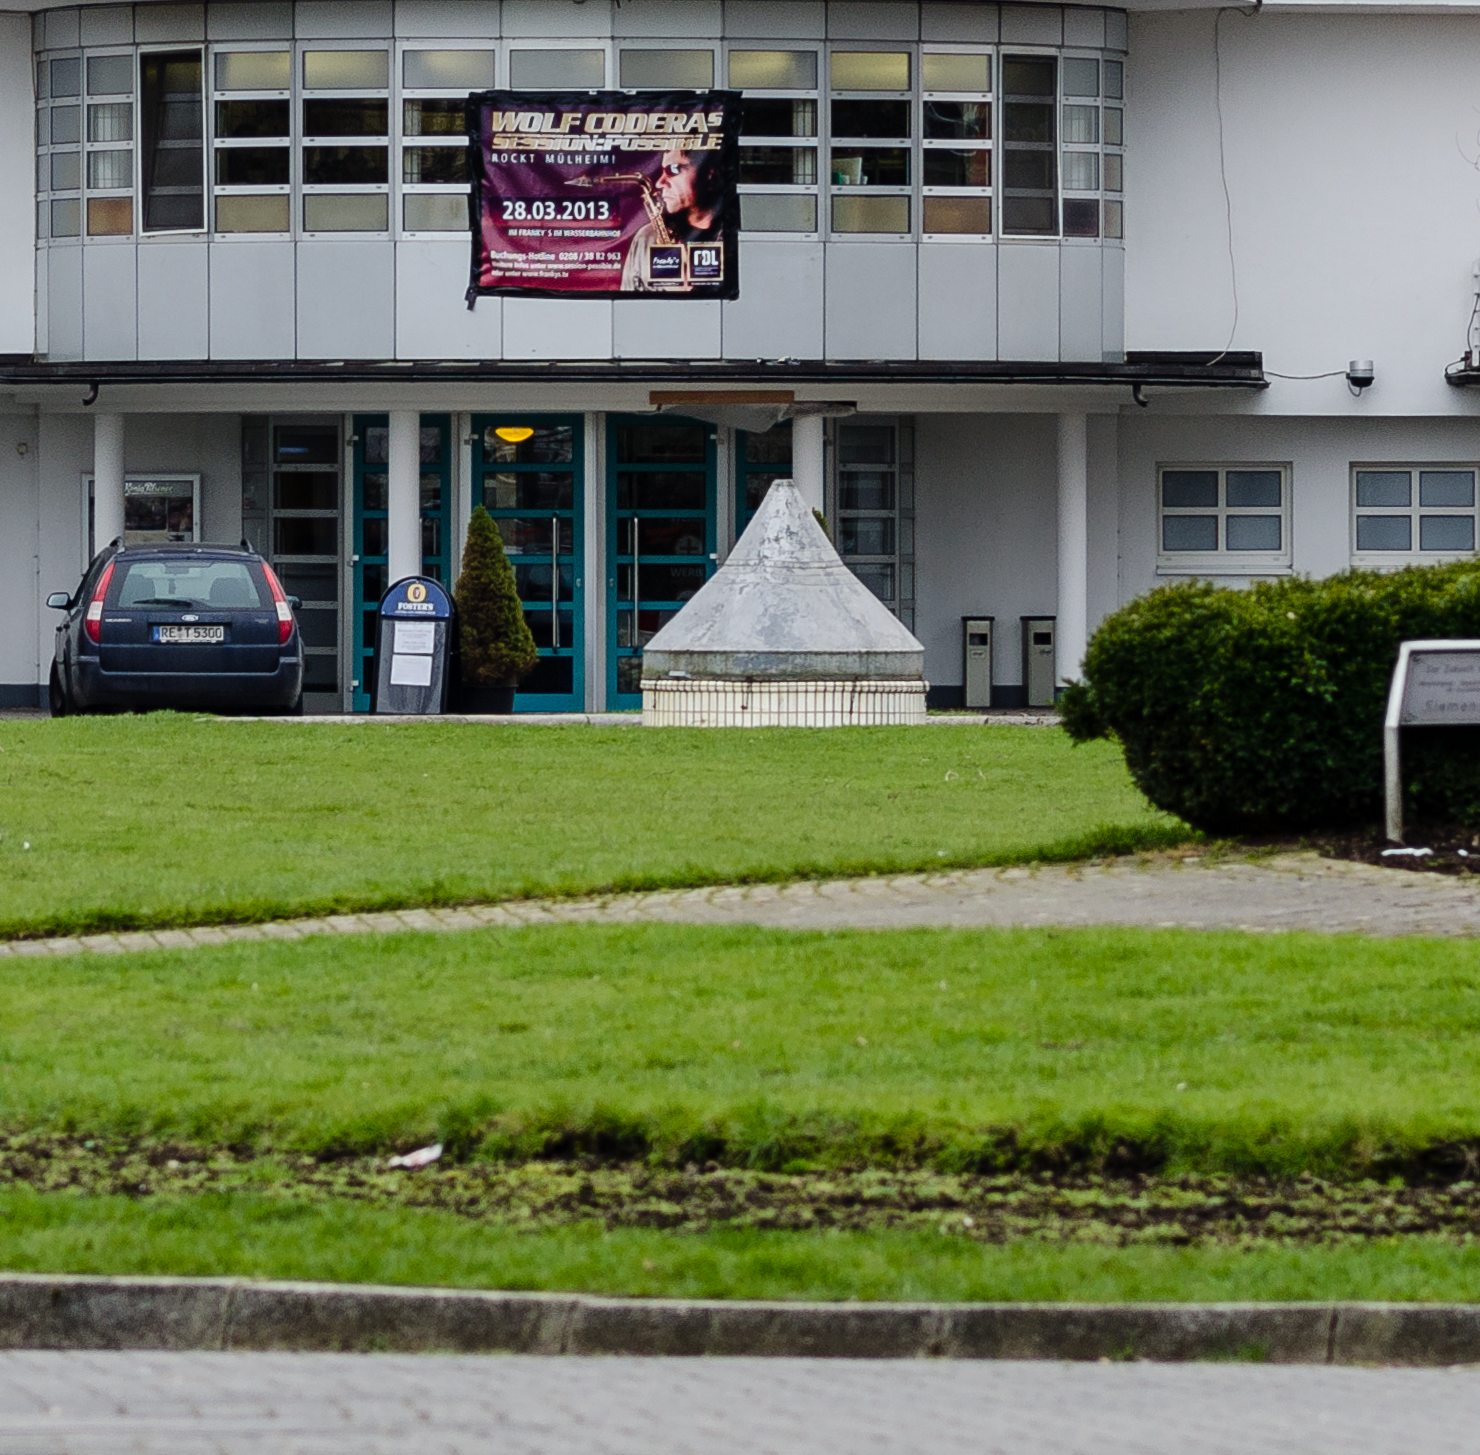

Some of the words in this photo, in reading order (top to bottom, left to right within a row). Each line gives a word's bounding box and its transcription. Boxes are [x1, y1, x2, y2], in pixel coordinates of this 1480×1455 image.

[491, 111, 582, 133] WOLF
[491, 133, 724, 151] SESSION:POSSIBLE
[491, 153, 536, 163] ROCKT
[545, 152, 617, 164] MÜLHEIM!
[502, 200, 610, 221] 28.03.2013
[161, 627, 176, 638] RE
[185, 627, 191, 638] T
[193, 627, 222, 639] 5300
